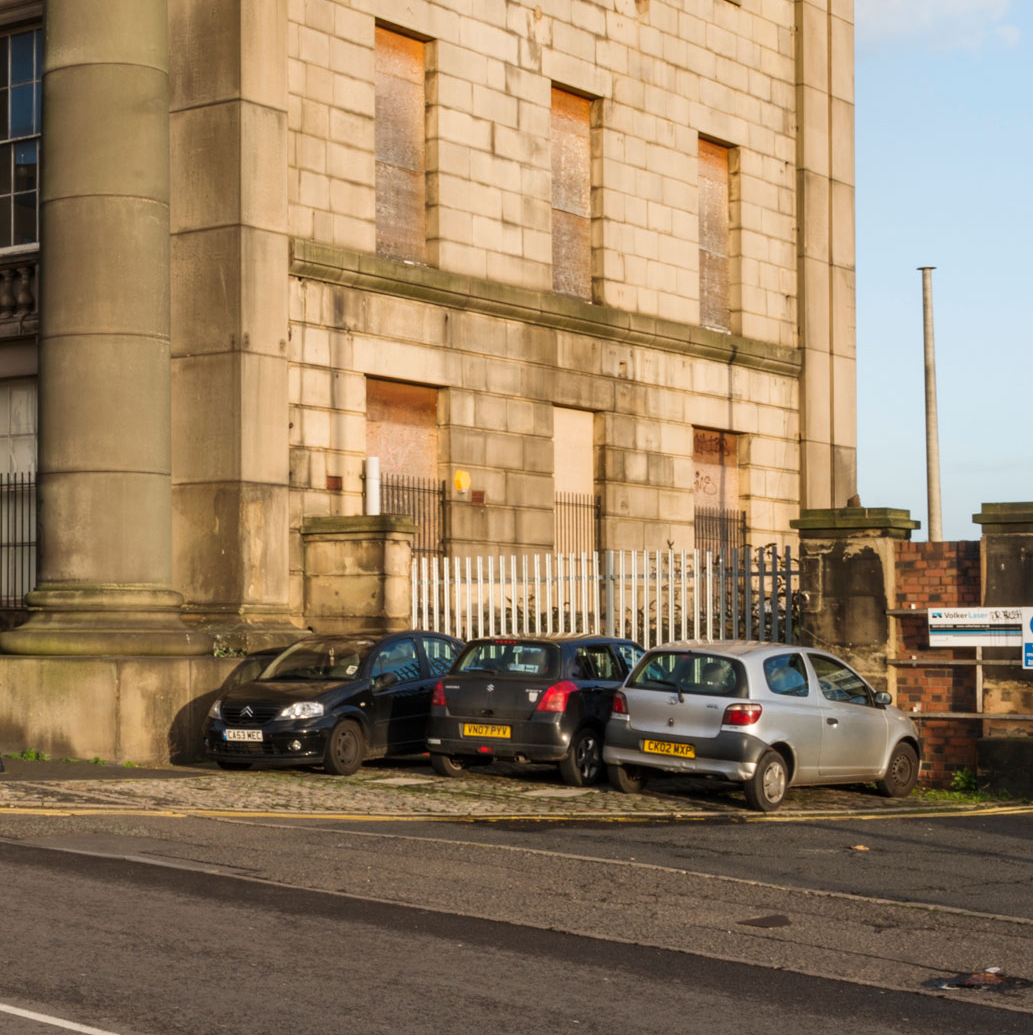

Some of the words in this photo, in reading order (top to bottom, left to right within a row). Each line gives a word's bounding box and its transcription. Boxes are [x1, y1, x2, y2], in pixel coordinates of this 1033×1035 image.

[227, 730, 246, 740] CA53
[468, 725, 489, 735] VN07
[491, 726, 508, 736] PYV
[647, 741, 672, 753] CK02
